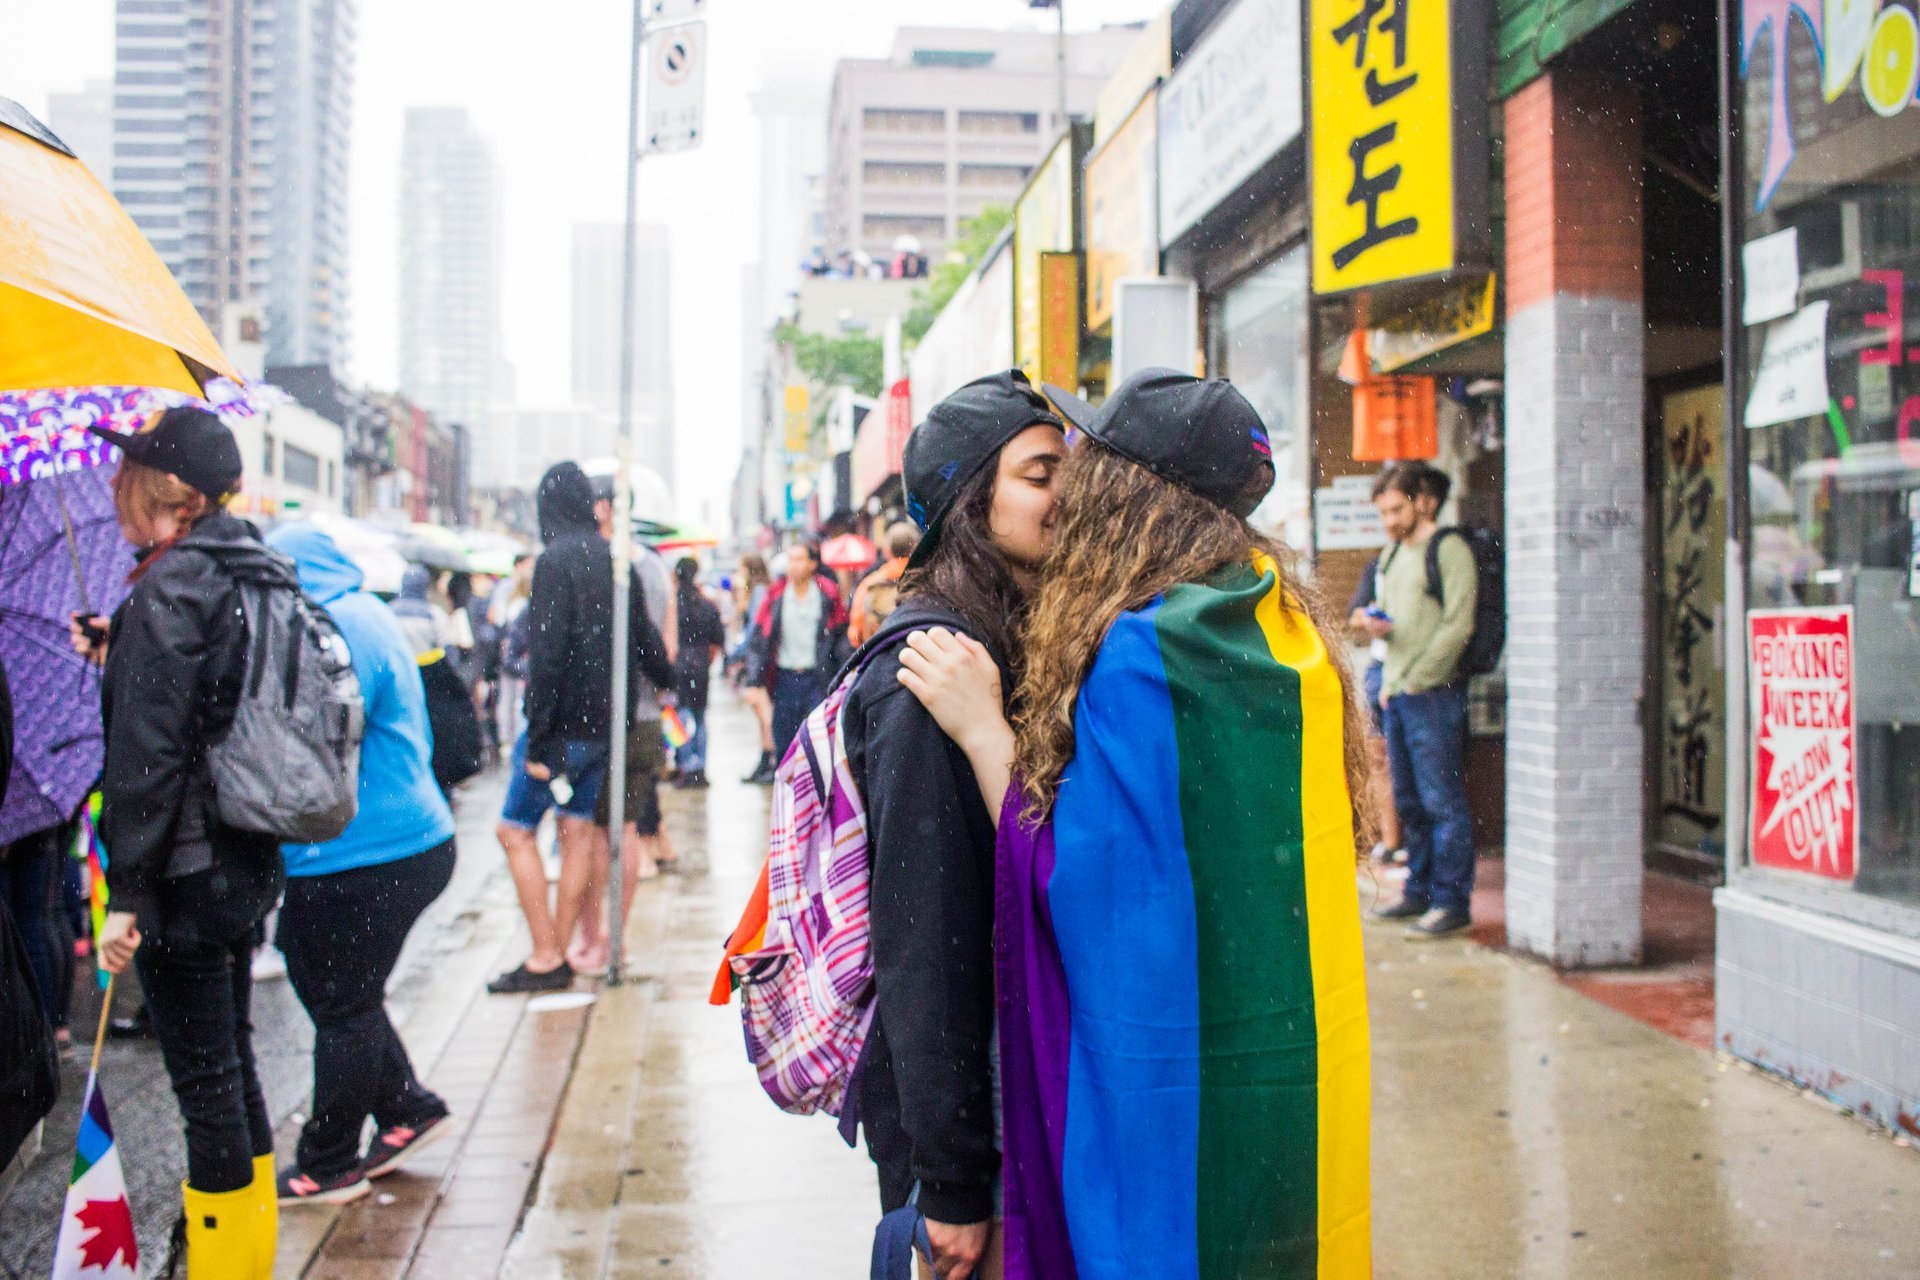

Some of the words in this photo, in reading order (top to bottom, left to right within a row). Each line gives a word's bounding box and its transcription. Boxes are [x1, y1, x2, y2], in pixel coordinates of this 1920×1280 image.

[1757, 634, 1848, 683] BOXING
[1769, 689, 1842, 729] WEEK
[1779, 735, 1832, 800] BLOW
[1784, 778, 1843, 859] OUT
